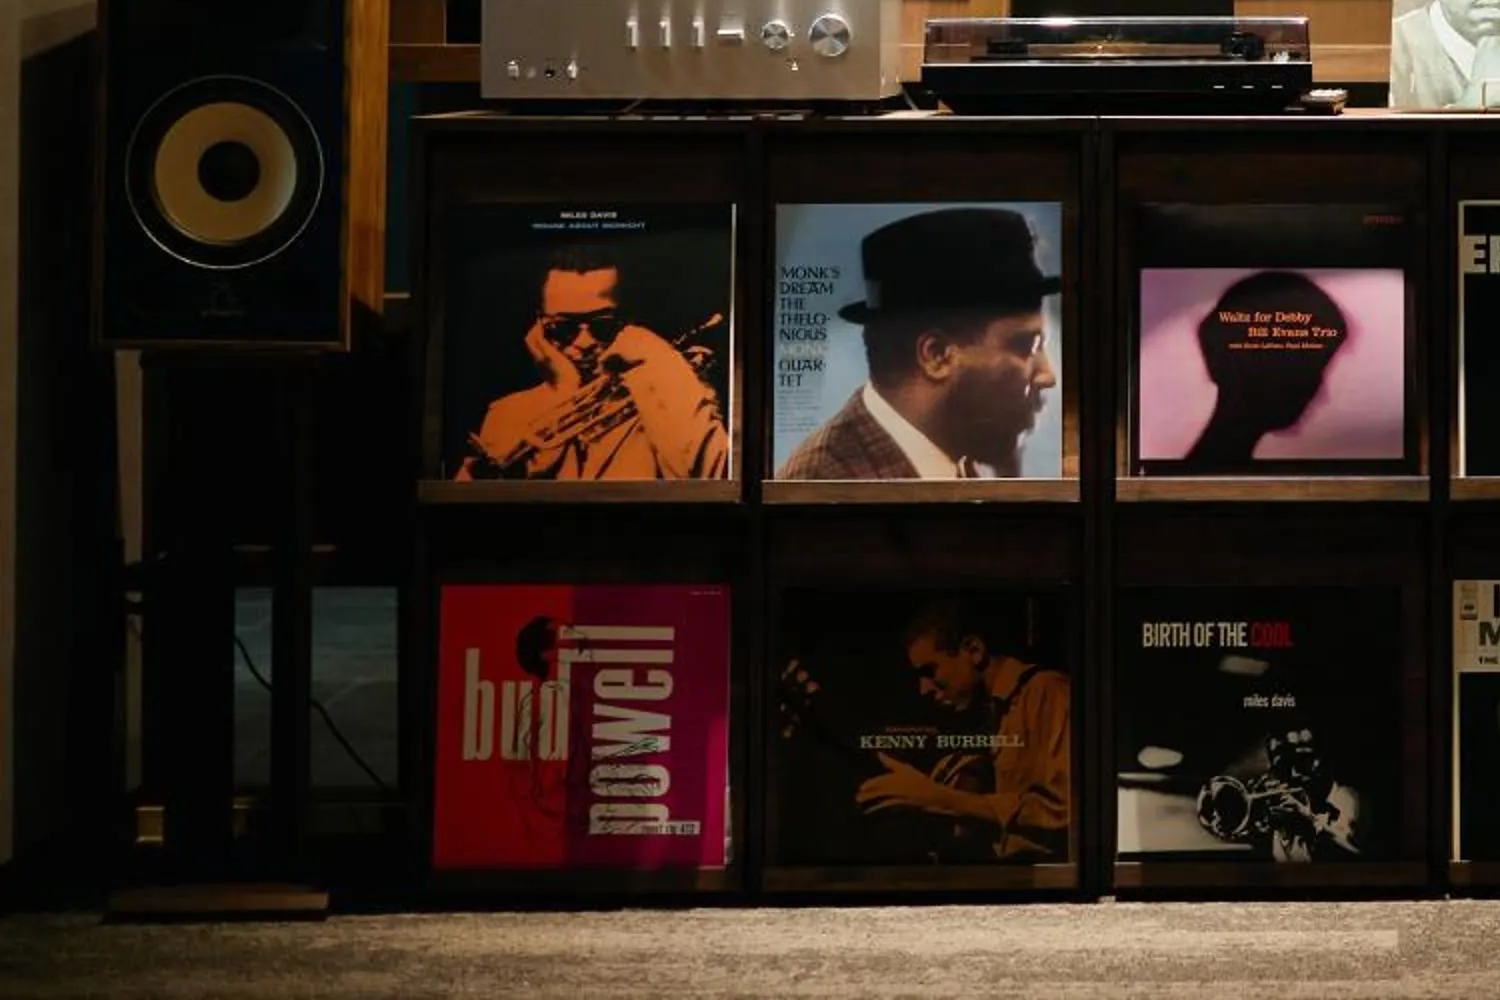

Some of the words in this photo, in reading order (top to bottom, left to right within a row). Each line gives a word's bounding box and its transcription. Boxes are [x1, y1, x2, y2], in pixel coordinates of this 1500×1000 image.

[780, 281, 833, 295] DREAM
[781, 297, 804, 311] THE
[1254, 311, 1273, 323] for
[1275, 311, 1313, 325] Debby
[780, 327, 828, 341] NIOUS
[1272, 327, 1309, 338] Evans
[1311, 327, 1338, 338] Trio
[779, 373, 802, 387] TET
[1142, 621, 1191, 648] BIRTH
[1193, 621, 1216, 648] OF
[1217, 620, 1249, 648] THE
[1251, 620, 1295, 648] COOL
[462, 647, 571, 761] bud
[1242, 693, 1269, 707] miles
[1271, 692, 1297, 707] davis
[558, 625, 701, 835] powell
[860, 734, 928, 749] KENNY
[935, 734, 1025, 748] BURRELL
